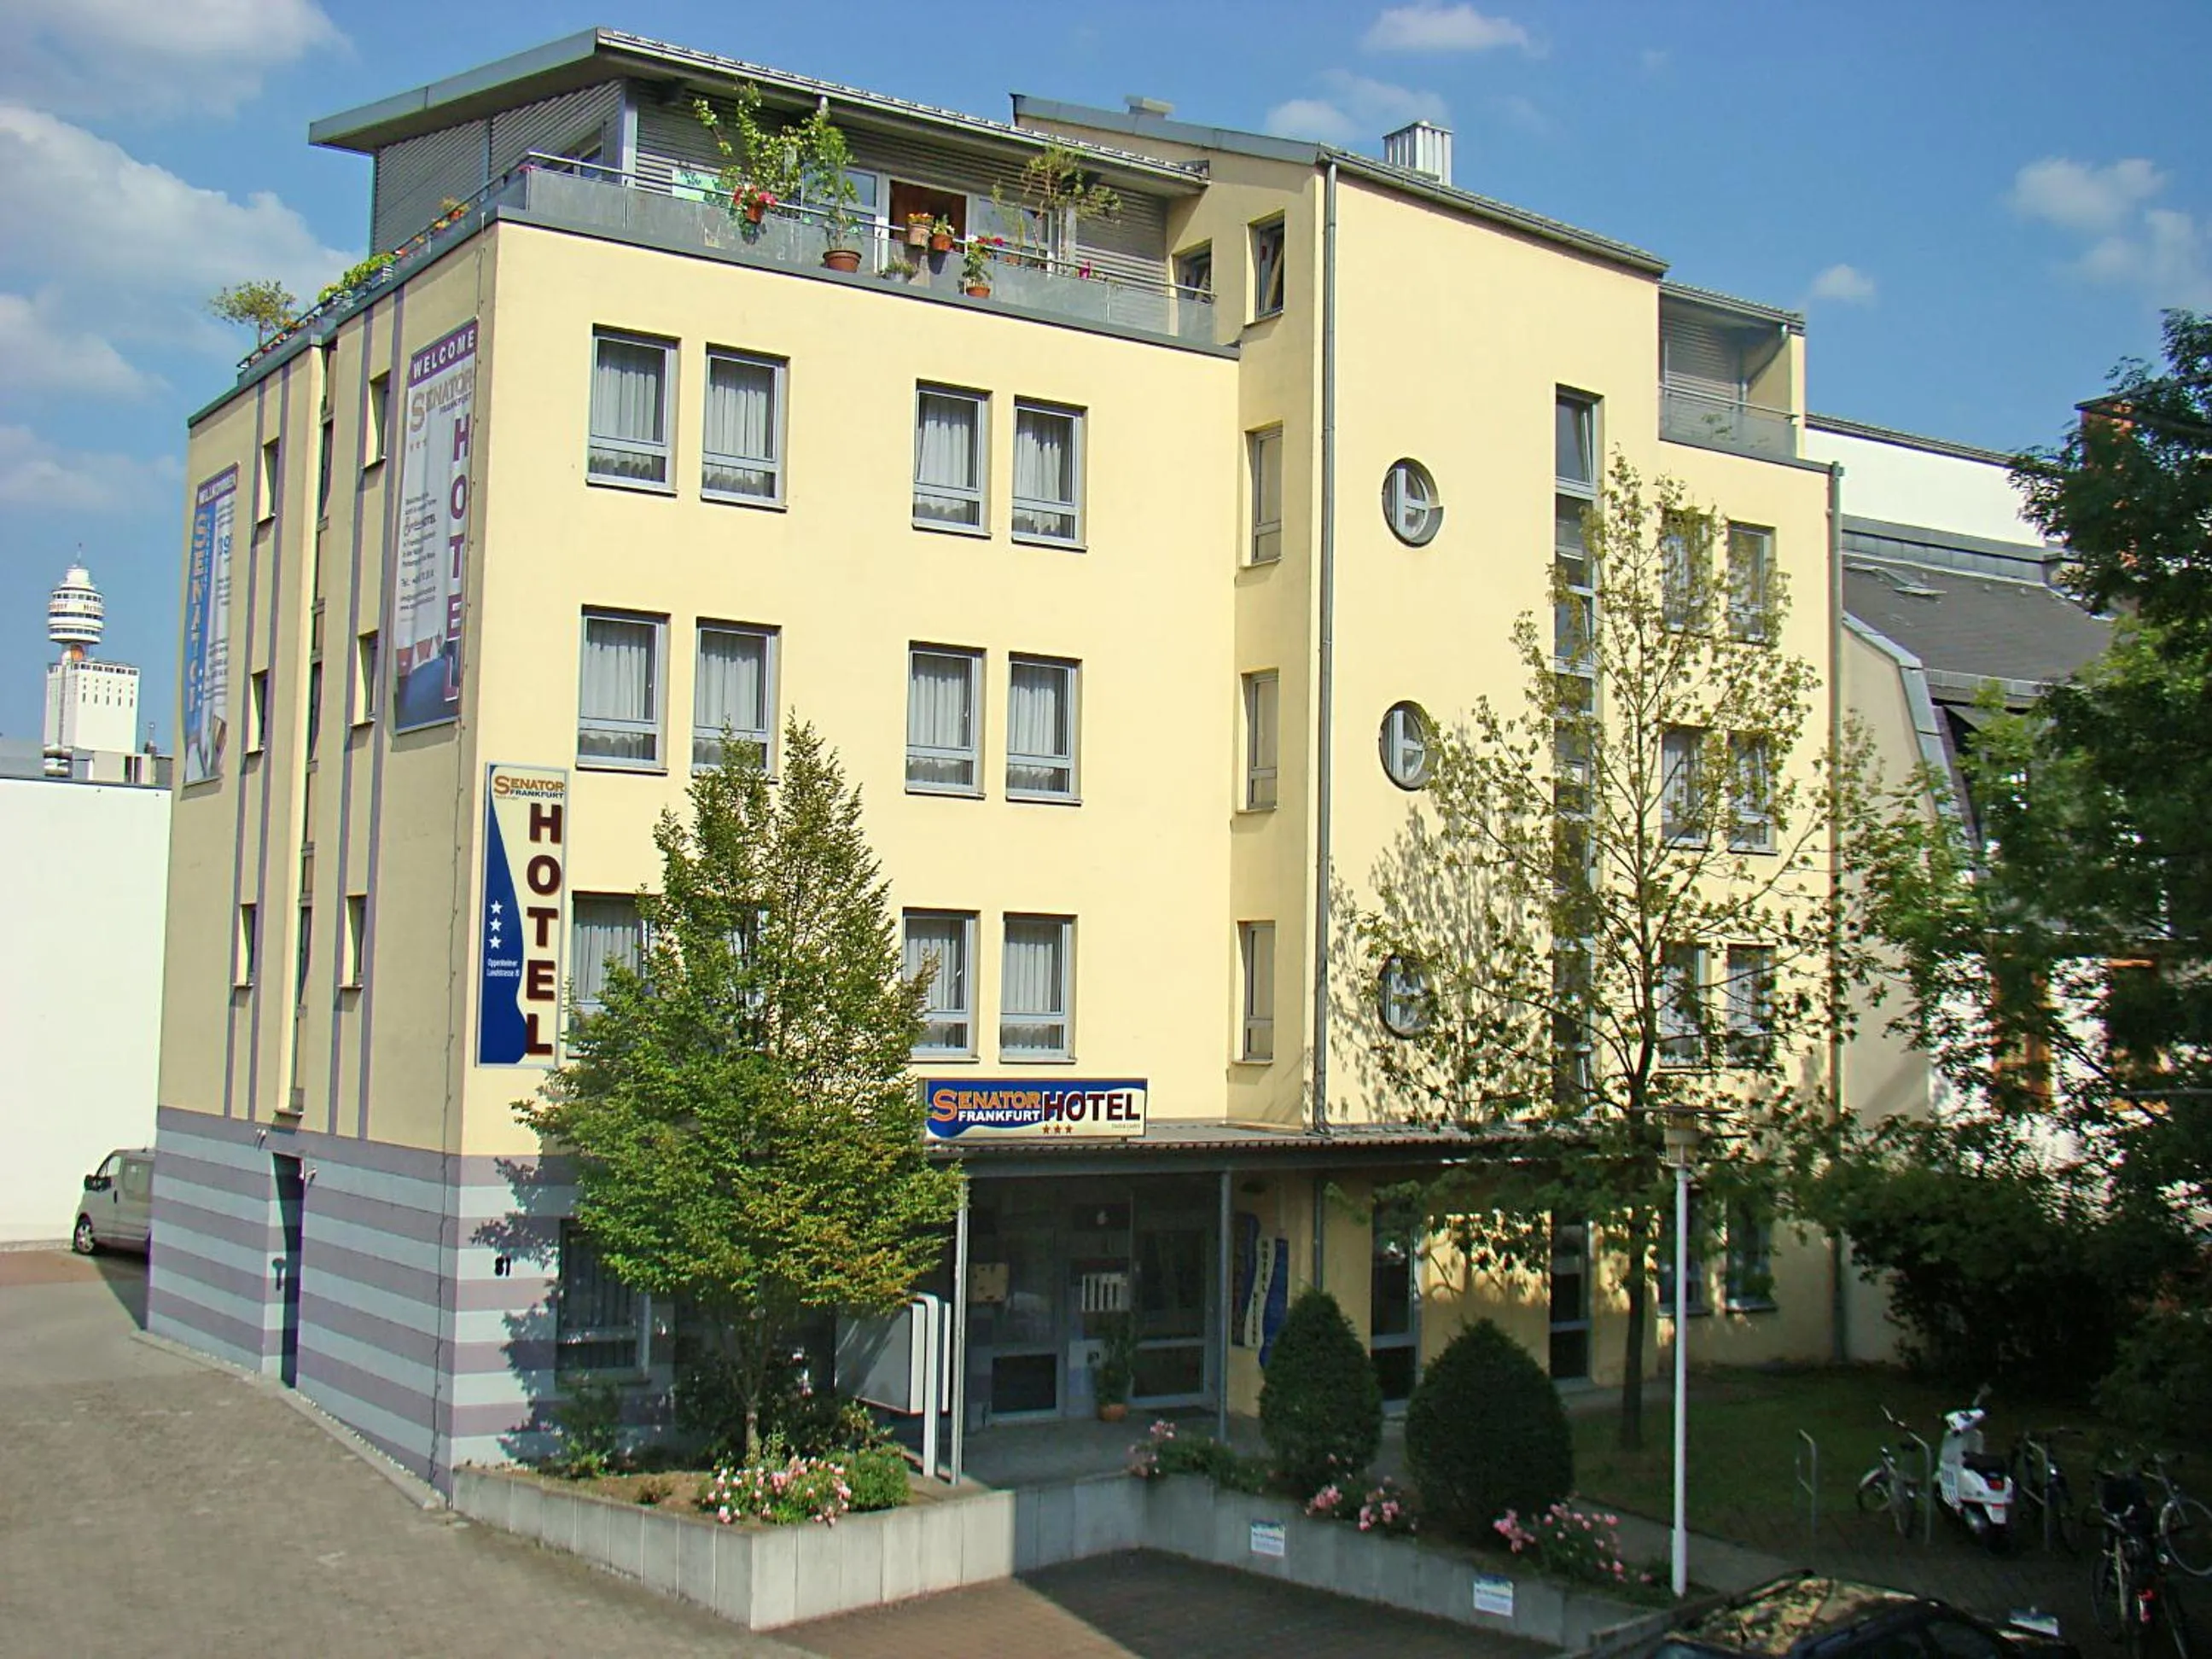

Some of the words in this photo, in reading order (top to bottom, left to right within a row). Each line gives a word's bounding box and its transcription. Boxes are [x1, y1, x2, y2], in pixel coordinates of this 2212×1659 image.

[413, 329, 474, 380] WELCOME
[410, 368, 474, 433] SENATOR
[445, 414, 469, 701] HOTEL
[494, 775, 565, 795] SENATOR
[509, 789, 565, 799] FRANKFURT
[527, 802, 562, 1056] HOTEL
[931, 1089, 1041, 1121] SENATOR
[958, 1110, 1040, 1121] FRANKFURT
[1042, 1093, 1140, 1121] HOTEL
